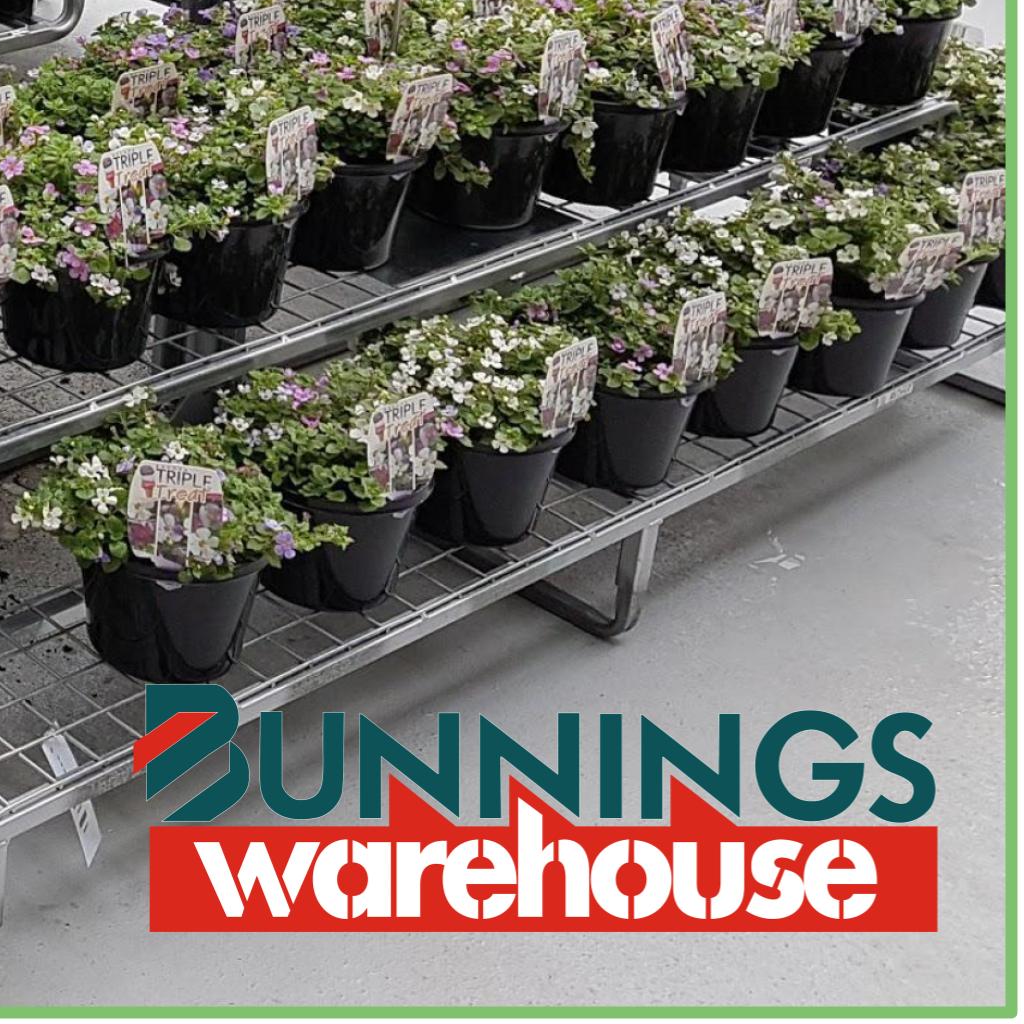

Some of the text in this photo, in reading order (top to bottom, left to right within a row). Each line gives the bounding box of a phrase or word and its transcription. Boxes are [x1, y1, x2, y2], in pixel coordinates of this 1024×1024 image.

[248, 10, 280, 27] TRIPLE
[130, 66, 171, 86] TRIPLE
[113, 148, 153, 171] TRIPLE
[785, 263, 828, 275] TRIPLE
[385, 399, 426, 424] TRIPLE
[156, 469, 213, 489] TRIPLE
